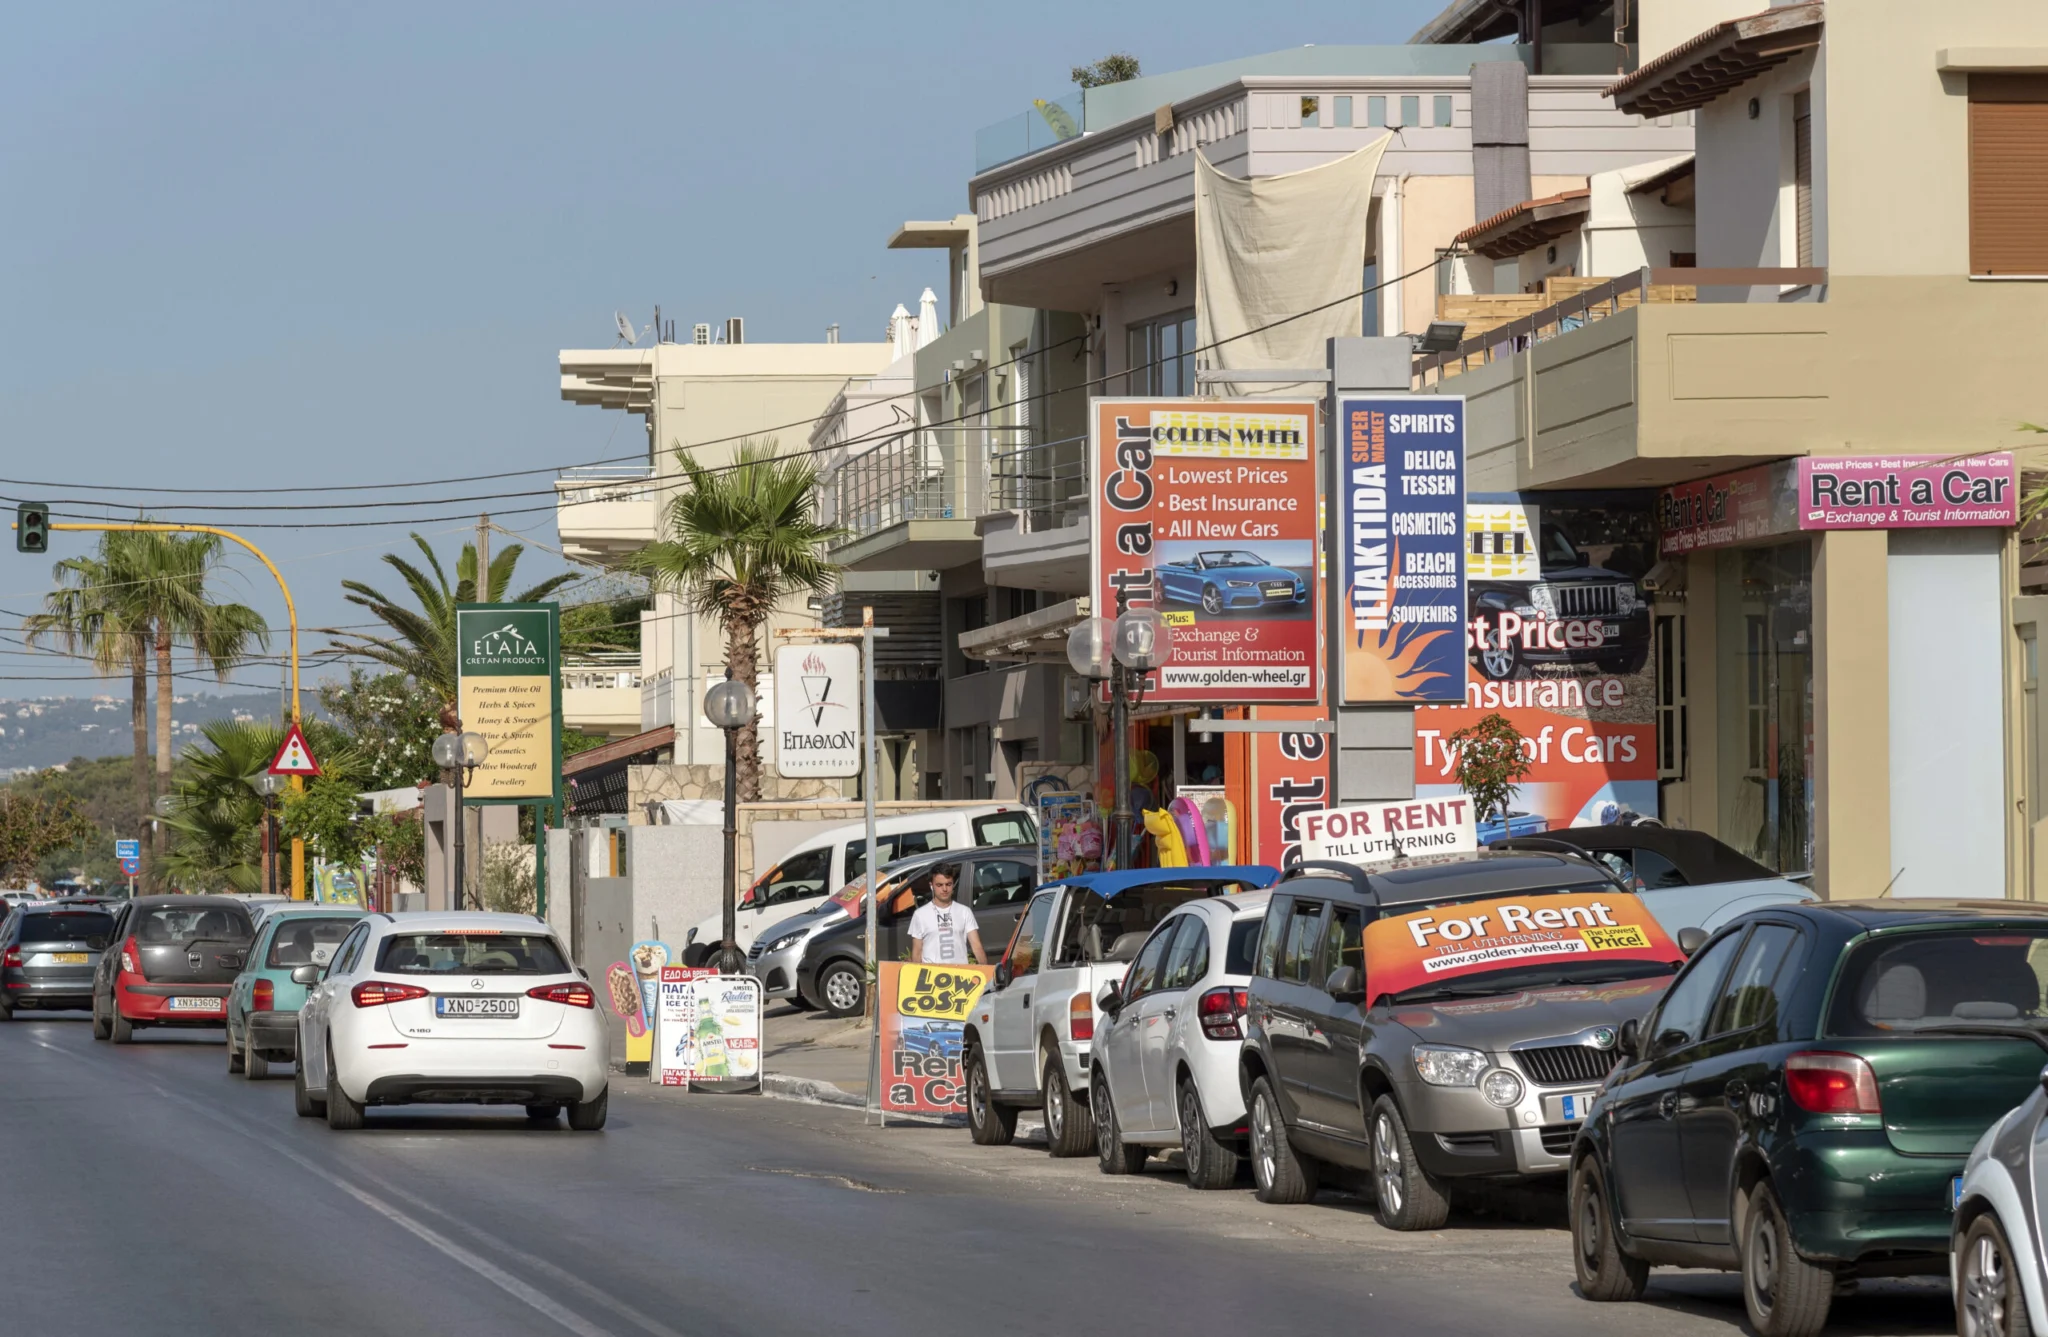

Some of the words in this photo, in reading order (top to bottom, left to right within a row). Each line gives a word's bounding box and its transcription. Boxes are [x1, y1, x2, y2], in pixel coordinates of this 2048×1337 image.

[1389, 414, 1455, 433] SPIRITS
[1152, 426, 1232, 445] GOLDEN
[1235, 428, 1305, 447] WHEEL
[1352, 411, 1369, 463] SUPER
[1371, 411, 1385, 463] MARKET
[1104, 416, 1155, 512] Car
[1404, 450, 1456, 470] DELICA
[1812, 460, 1844, 470] Lowest
[1846, 459, 1873, 470] Prices
[1881, 459, 1900, 469] Best
[1967, 457, 1986, 467] New
[1988, 457, 2009, 467] Cars
[1169, 466, 1232, 484] Lowest
[1237, 467, 1288, 484] Prices
[1400, 475, 1456, 495] TESSEN
[1811, 473, 1901, 507] Rent
[1909, 477, 1934, 506] a
[1941, 469, 2009, 505] Car
[1169, 494, 1207, 511] Best
[1212, 495, 1297, 511] Insurance
[1663, 488, 1692, 531] Rent
[1695, 493, 1703, 526] a
[1705, 482, 1729, 523] Car
[1391, 512, 1456, 535] COSMETICS
[1825, 510, 1886, 524] Exchange
[1888, 510, 1899, 522] &
[1902, 509, 1940, 522] Tourist
[1943, 508, 2010, 521] Information
[1169, 520, 1192, 537] All
[1197, 521, 1231, 537] New
[1235, 521, 1279, 537] Cars
[1116, 521, 1154, 556] a
[1353, 464, 1388, 630] ILIAKTIDA
[1680, 530, 1694, 551] Prices
[1697, 527, 1709, 547] Best
[1405, 552, 1456, 573] BEACH
[1393, 575, 1457, 589] ACCESSORIES
[1392, 605, 1457, 623] SOUVENIRS
[1171, 628, 1241, 645] Exchange
[1244, 627, 1260, 641] &
[1498, 609, 1605, 651] Prices
[474, 640, 538, 655] ELAIA
[1172, 647, 1218, 662] Tourist
[1222, 647, 1305, 662] Information
[466, 657, 500, 665] CRETAN
[1165, 667, 1306, 686] www.golden-wheel.gr
[472, 686, 507, 694] Premium
[508, 685, 529, 694] Olive
[529, 685, 541, 693] Oil
[479, 701, 502, 709] Herbs
[503, 701, 510, 709] &
[512, 701, 536, 710] Spices
[477, 717, 503, 726] Honey
[512, 716, 538, 724] Sweets
[480, 732, 500, 740] Wine
[509, 731, 534, 740] Spirits
[1560, 726, 1638, 764] Cars
[489, 747, 527, 755] Cosmetics
[500, 762, 538, 771] Woodcraft
[490, 778, 527, 787] Jewellery
[1307, 811, 1372, 841] FOR
[1383, 800, 1467, 833] RENT
[1325, 843, 1359, 857] TILL
[1363, 832, 1457, 854] UTHYRNING
[1406, 914, 1490, 947] For
[1497, 901, 1619, 933] Rent
[1584, 929, 1603, 937] The
[1604, 926, 1638, 936] Lowest
[1435, 943, 1469, 956] TILL
[1472, 931, 1564, 949] UTHYRNING
[1591, 933, 1645, 949] Price!
[1428, 940, 1581, 970] www.golden-wheel.gr
[914, 968, 982, 998] LOW
[901, 990, 968, 1015] COST
[702, 1038, 723, 1047] AMSTEL
[889, 1083, 917, 1106] a
